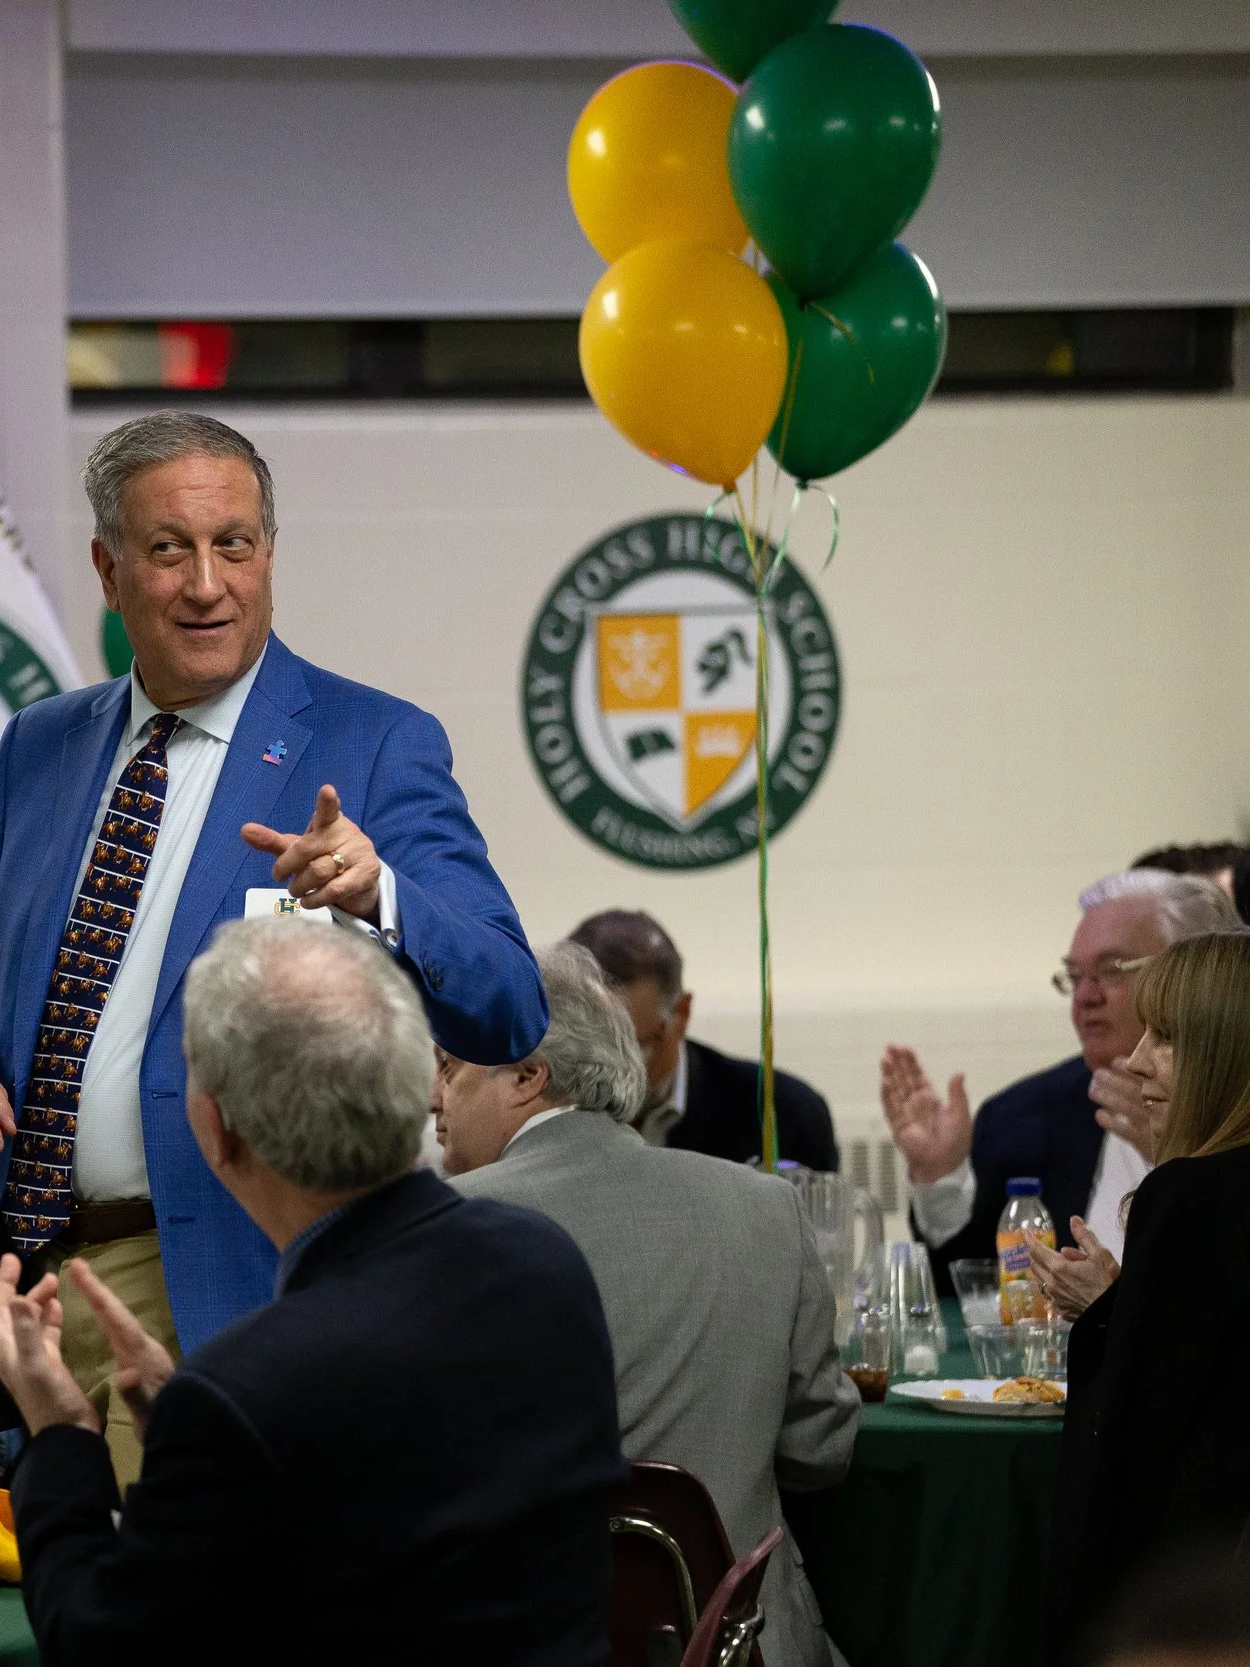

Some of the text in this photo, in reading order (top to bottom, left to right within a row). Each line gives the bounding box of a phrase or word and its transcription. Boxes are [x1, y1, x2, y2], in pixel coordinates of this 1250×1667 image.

[539, 524, 657, 654] CROSS
[528, 662, 592, 801] HOLY
[775, 590, 837, 792] SCHOOL
